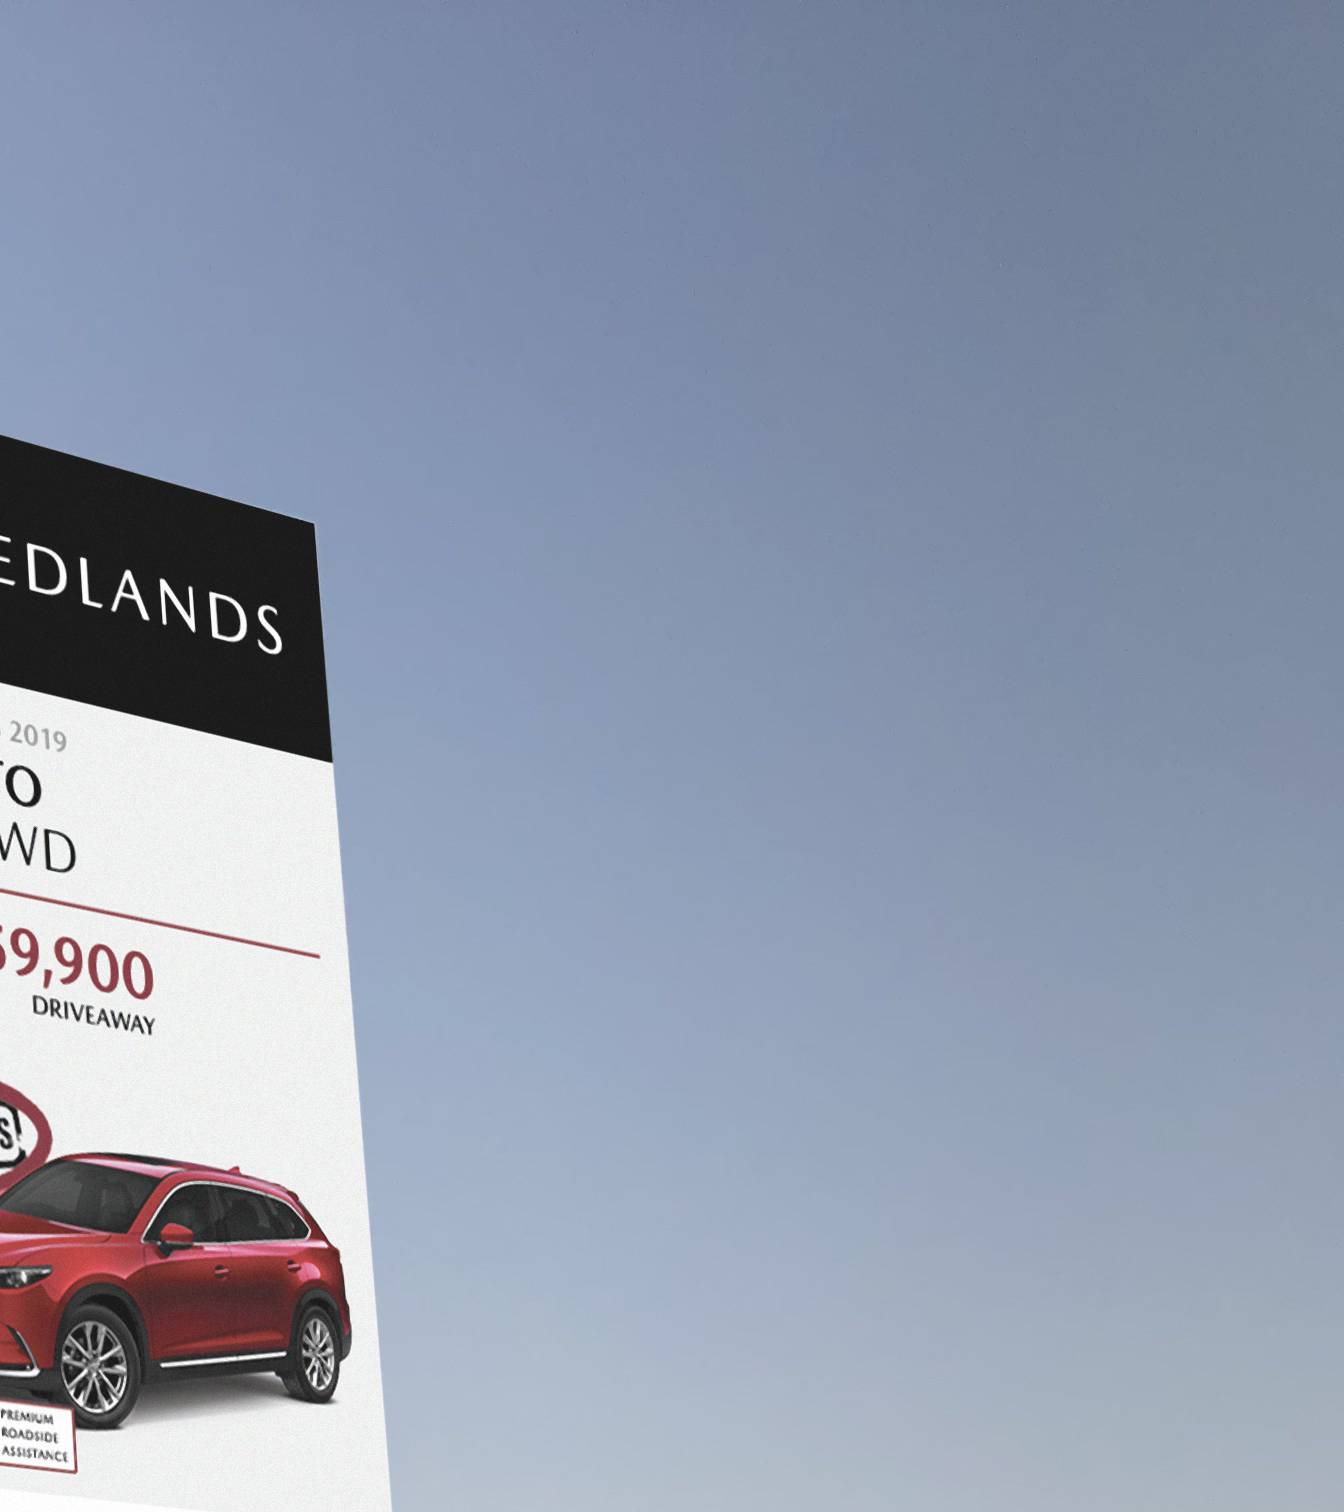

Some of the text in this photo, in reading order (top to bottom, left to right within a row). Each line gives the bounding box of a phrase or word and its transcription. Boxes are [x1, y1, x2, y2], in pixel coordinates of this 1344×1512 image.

[10, 720, 67, 753] 2019
[32, 995, 155, 1036] DRIVEAWAY
[0, 1408, 54, 1425] PREMIUM
[1, 1427, 60, 1444] ROADSIDE
[1, 1447, 69, 1464] ASSISTANCE
